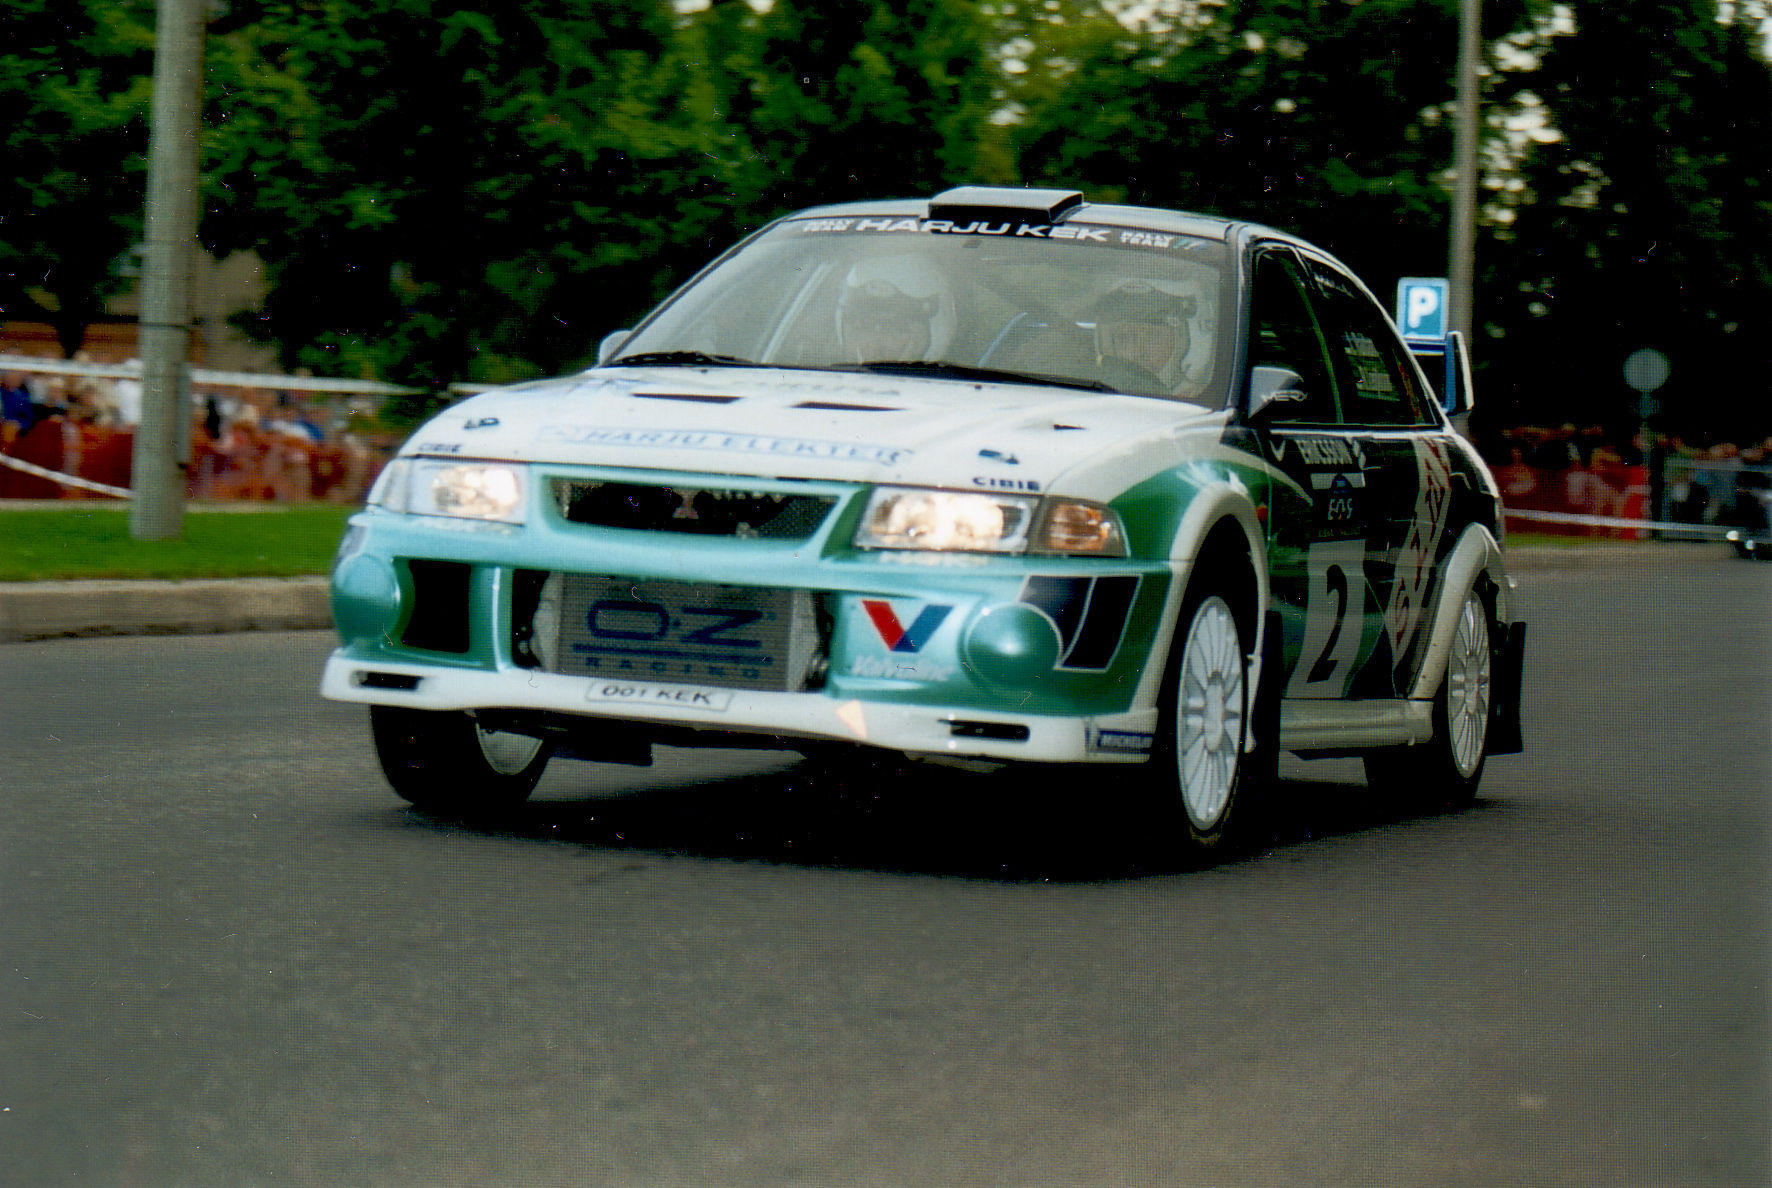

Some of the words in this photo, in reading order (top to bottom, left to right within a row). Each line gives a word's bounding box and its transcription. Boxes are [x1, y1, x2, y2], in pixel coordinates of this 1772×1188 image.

[856, 218, 1011, 236] HARJU
[1016, 223, 1112, 242] KEK
[1407, 285, 1439, 329] P
[1306, 564, 1348, 684] 2
[585, 656, 760, 679] RACING
[657, 689, 712, 705] KEK
